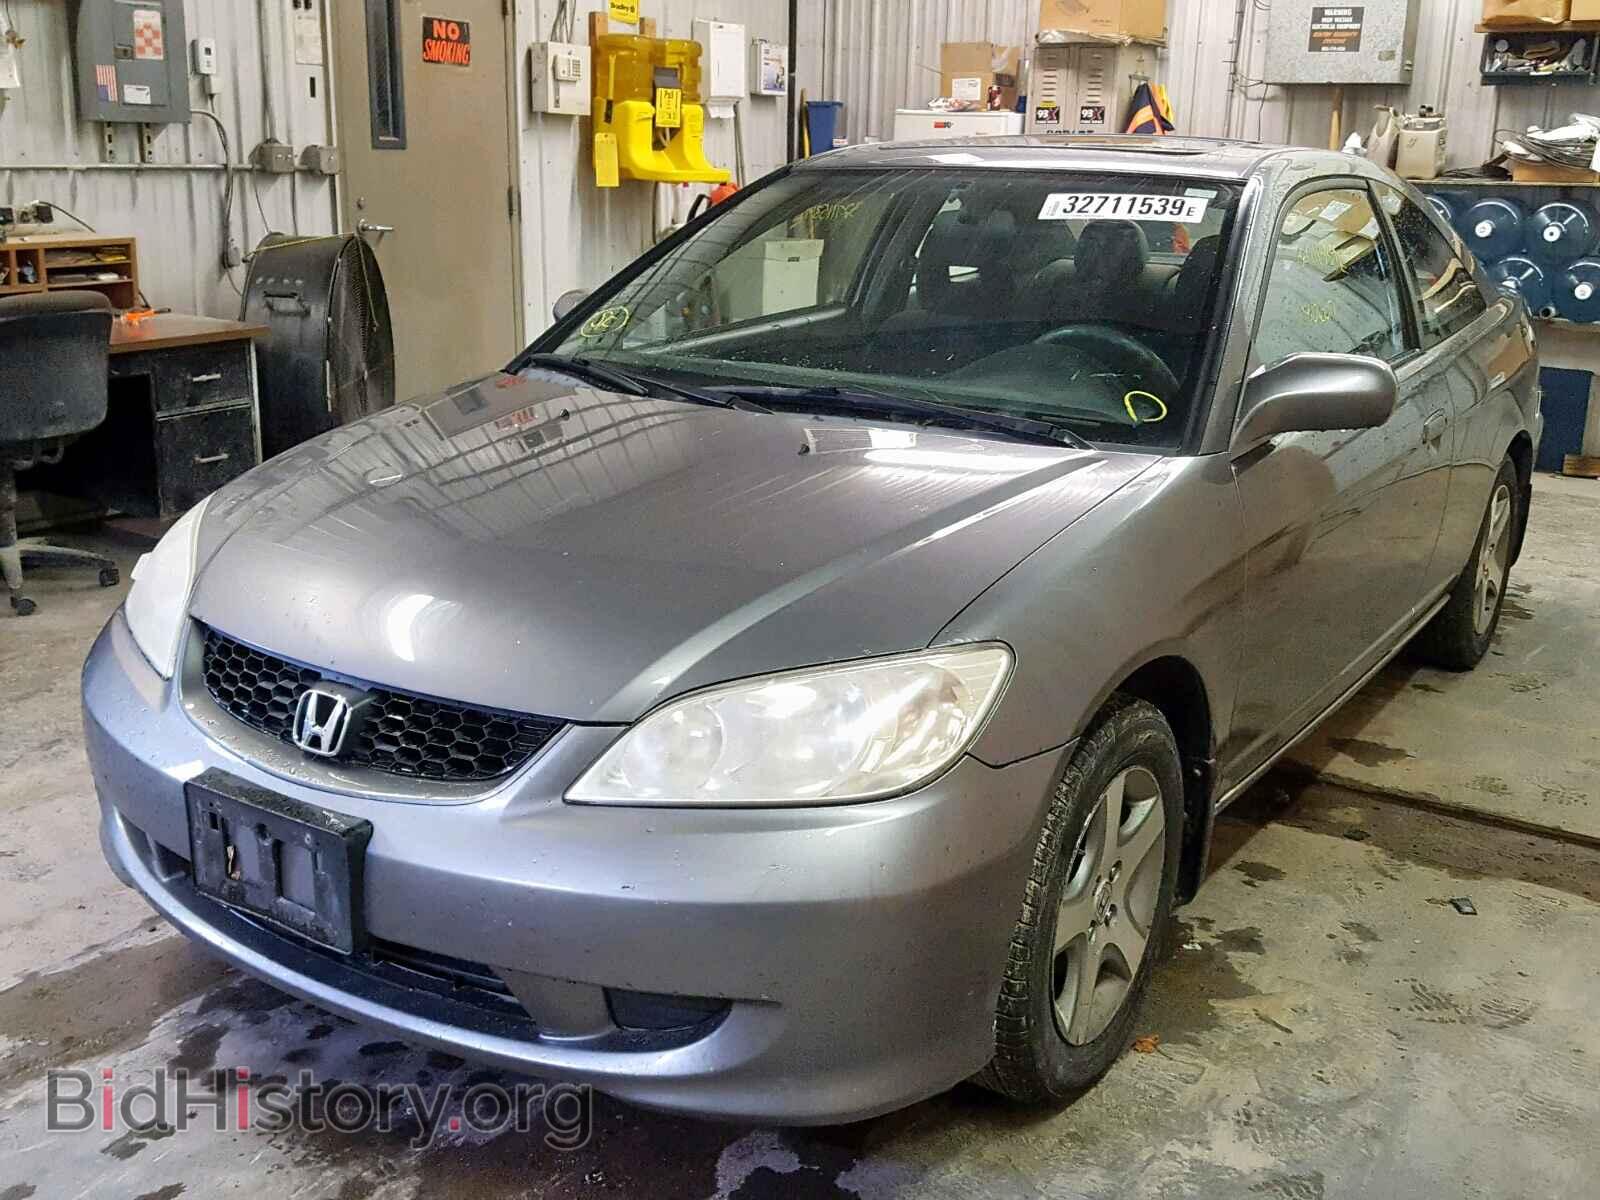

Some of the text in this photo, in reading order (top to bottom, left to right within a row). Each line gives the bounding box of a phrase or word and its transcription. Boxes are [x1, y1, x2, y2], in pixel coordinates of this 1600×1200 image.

[433, 20, 460, 40] NO
[423, 38, 470, 65] SMOKING
[1062, 195, 1186, 217] 32711539
[1186, 206, 1197, 217] E
